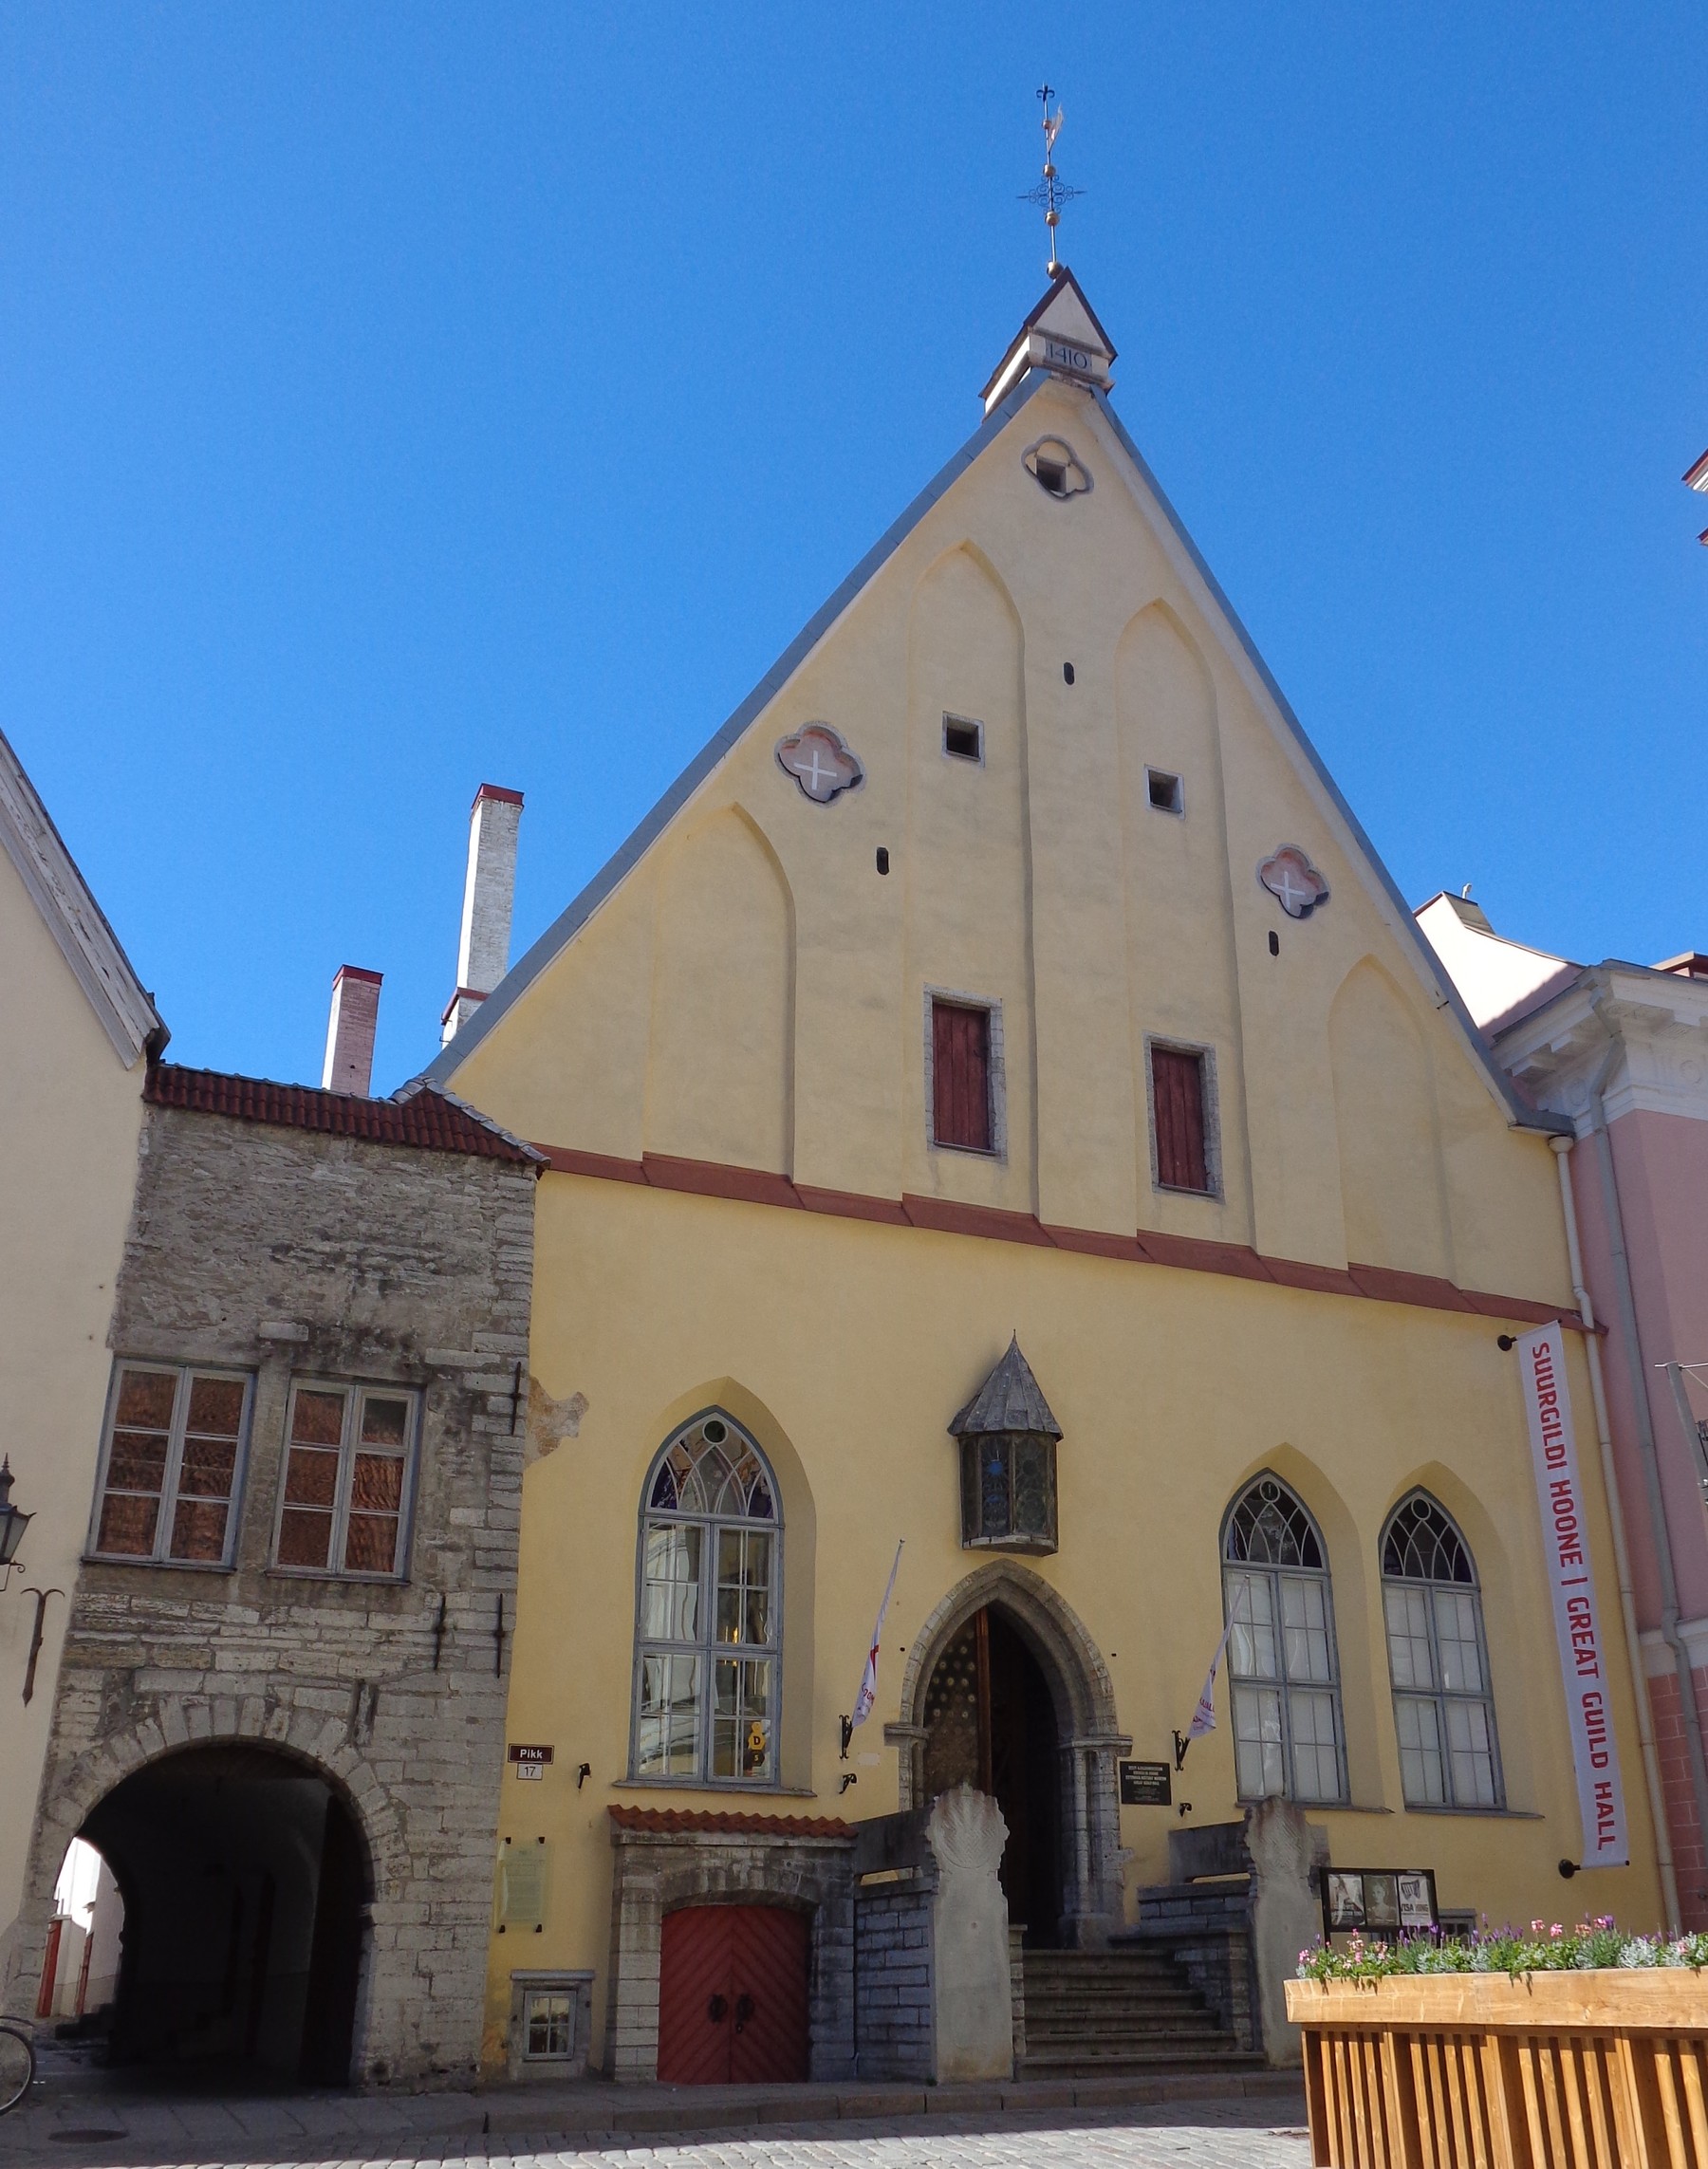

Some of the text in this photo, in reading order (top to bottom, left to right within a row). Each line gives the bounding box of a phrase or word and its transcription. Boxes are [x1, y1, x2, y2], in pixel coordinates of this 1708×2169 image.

[1049, 343, 1087, 369] 1410
[1532, 1342, 1568, 1471] SUURGILDI
[1550, 1479, 1584, 1568] HOONE
[1567, 1596, 1600, 1679] GREAT
[519, 1749, 543, 1759] Pikk
[1582, 1691, 1608, 1770] GUILD
[524, 1766, 536, 1777] 17
[1594, 1781, 1616, 1851] HALL
